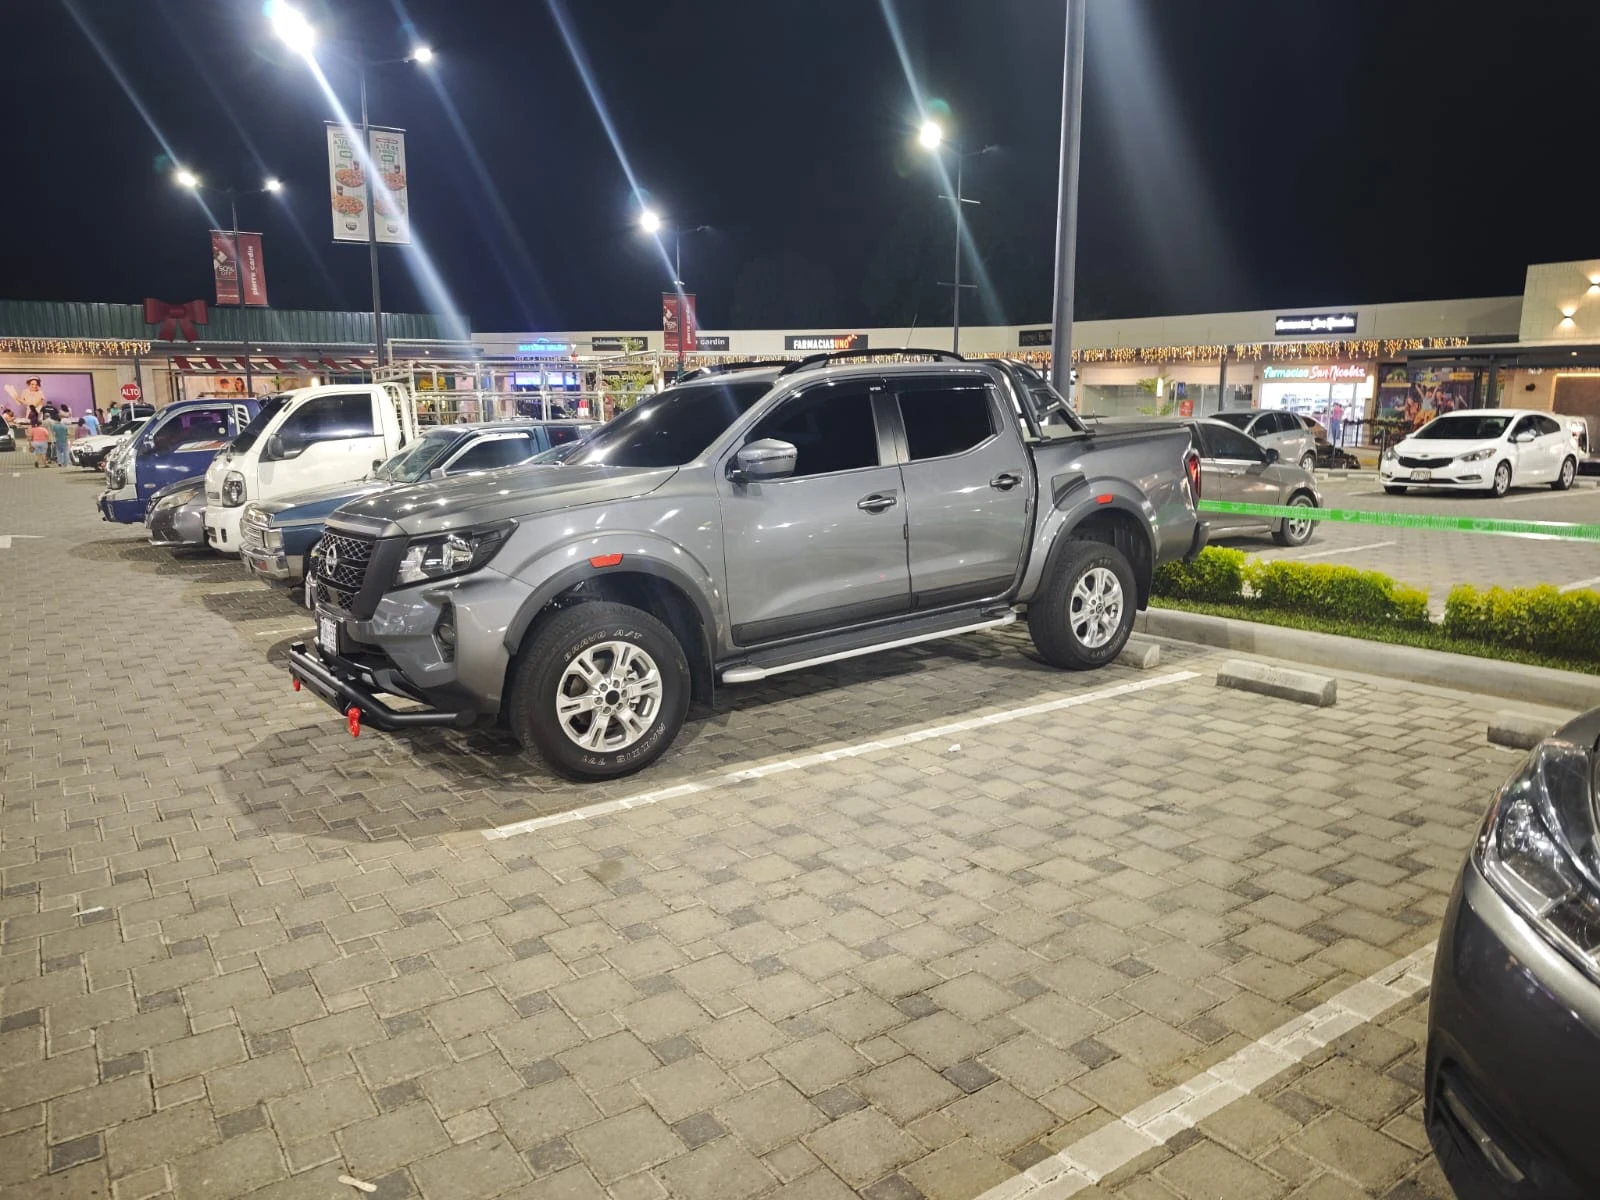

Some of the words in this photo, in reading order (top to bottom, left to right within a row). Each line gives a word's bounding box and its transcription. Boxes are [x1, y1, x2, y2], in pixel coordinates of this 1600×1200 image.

[247, 245, 255, 271] cardin
[700, 337, 726, 346] cardin
[1309, 365, 1329, 380] San
[122, 388, 139, 396] ALTO
